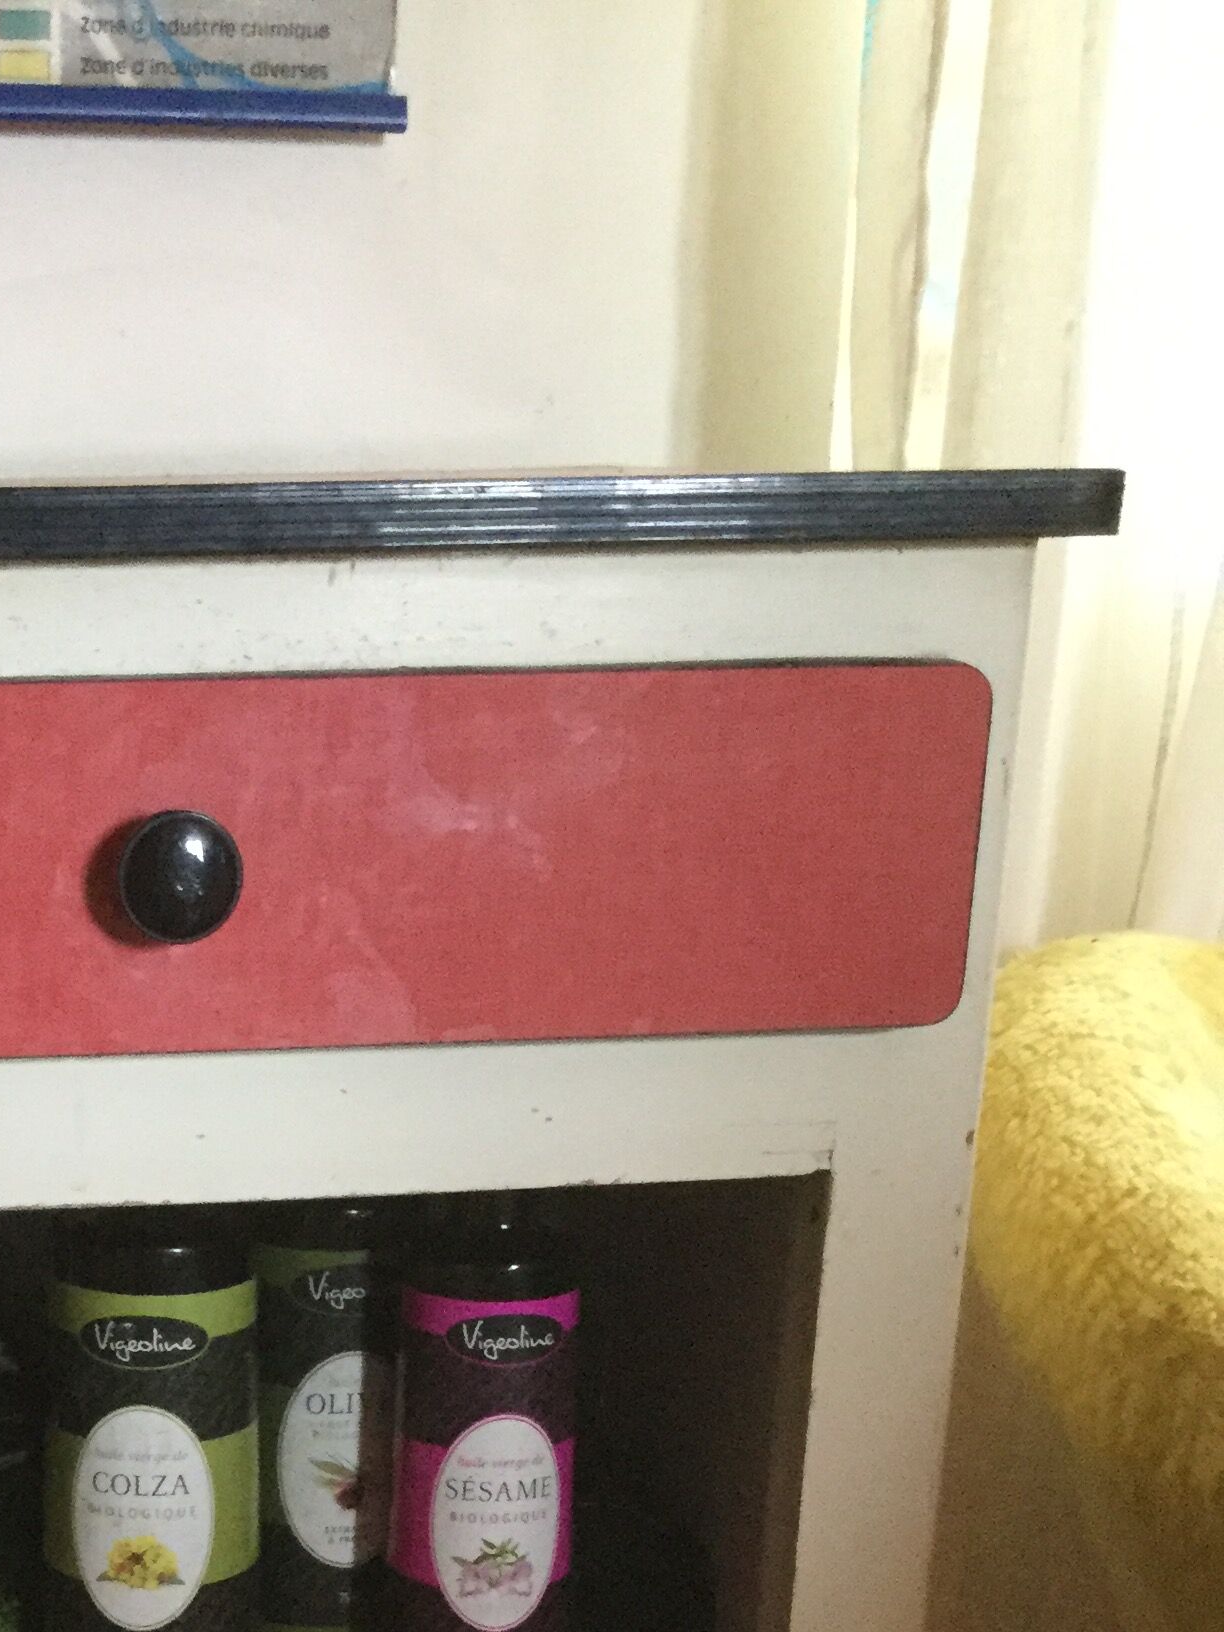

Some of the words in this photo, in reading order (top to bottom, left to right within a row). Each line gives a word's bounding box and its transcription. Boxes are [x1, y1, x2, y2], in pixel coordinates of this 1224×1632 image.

[80, 56, 126, 75] Zone
[92, 1471, 191, 1497] COLZA
[445, 1475, 552, 1502] SÉSAME
